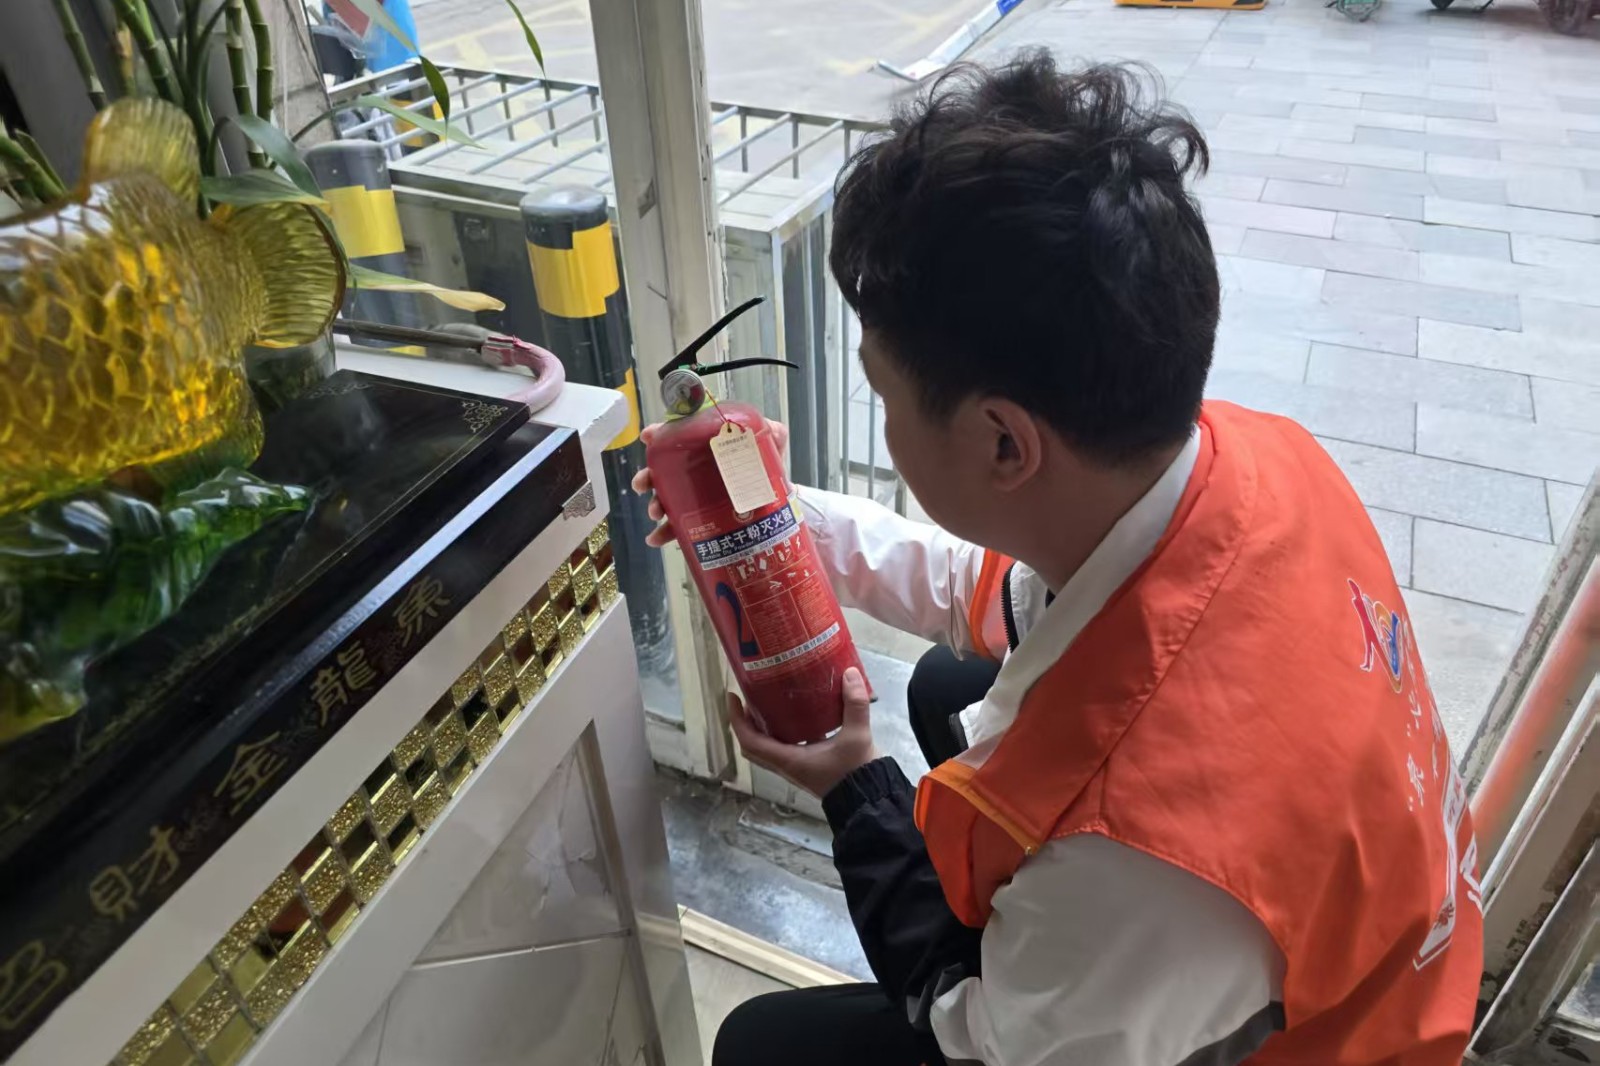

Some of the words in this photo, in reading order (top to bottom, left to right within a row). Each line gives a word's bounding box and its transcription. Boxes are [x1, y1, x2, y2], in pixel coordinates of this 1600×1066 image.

[696, 507, 794, 557] 手提式干粉灭火器
